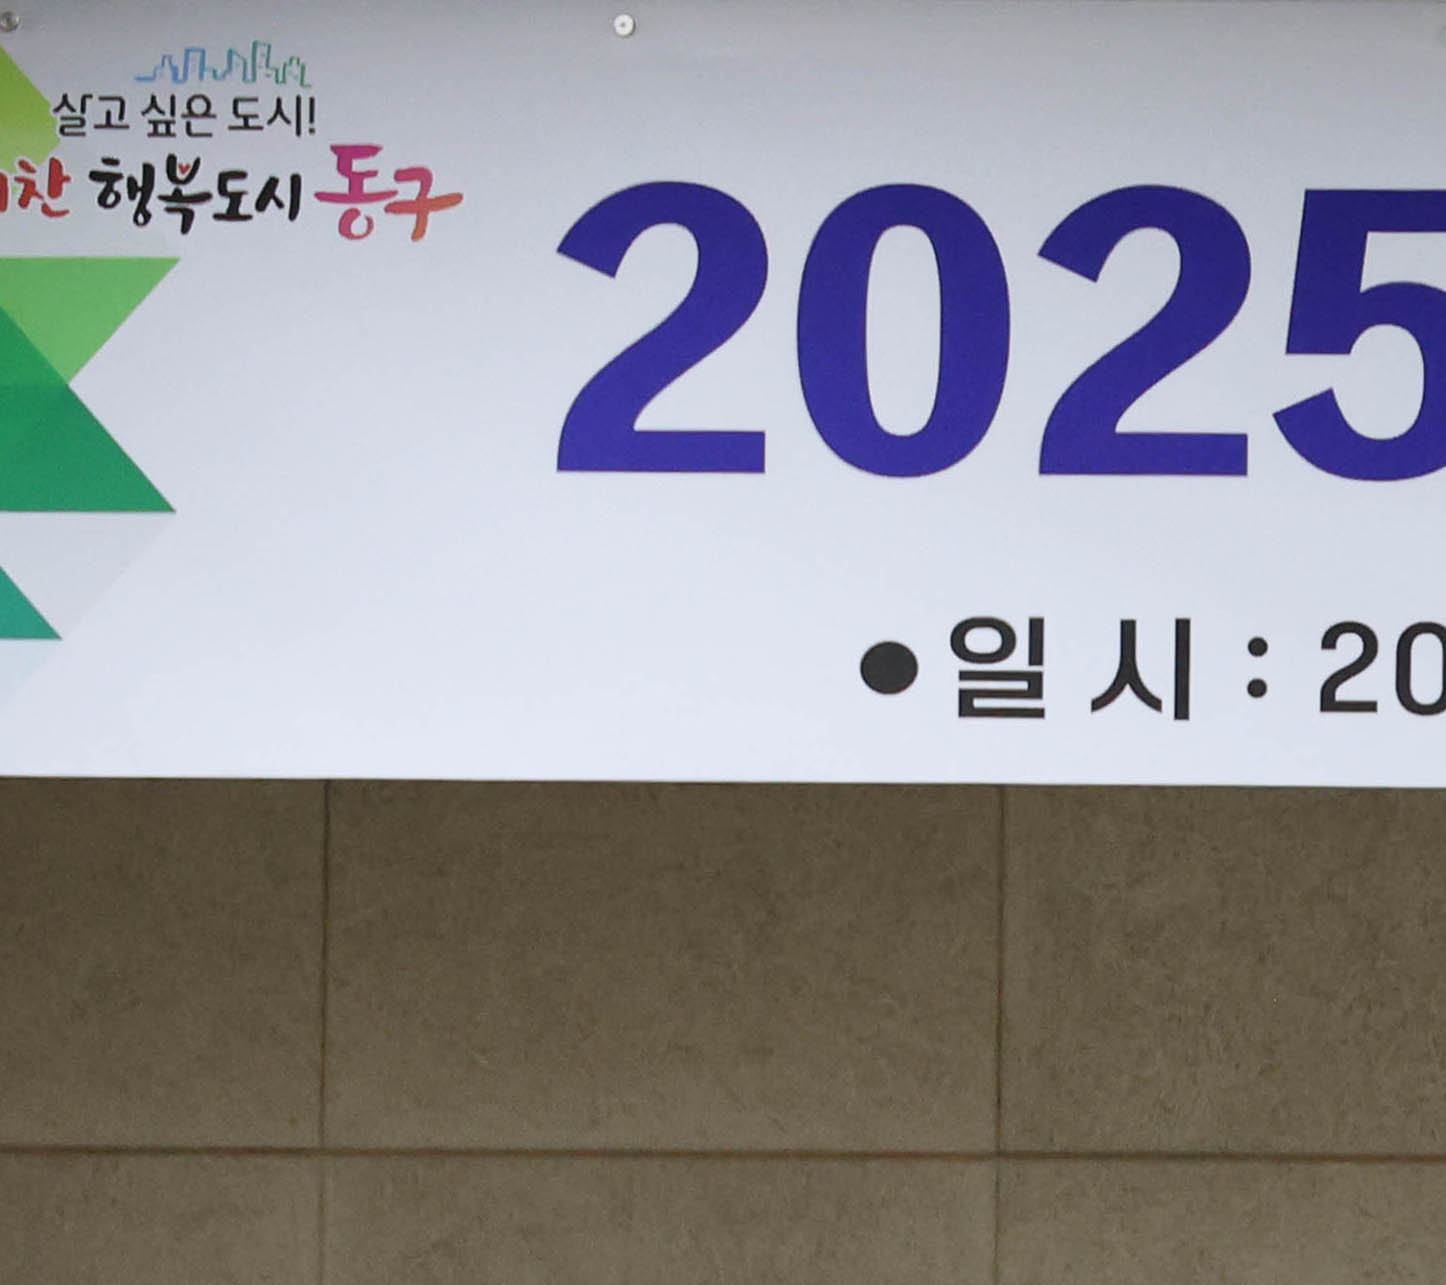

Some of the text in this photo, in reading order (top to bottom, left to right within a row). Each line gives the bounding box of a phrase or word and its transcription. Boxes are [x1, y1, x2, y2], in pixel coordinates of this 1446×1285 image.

[52, 92, 317, 139] 살고 싶은 도시!
[87, 152, 302, 236] 행복도시
[313, 143, 465, 242] 동구
[949, 616, 1046, 719] 일
[1090, 618, 1191, 721] 시
